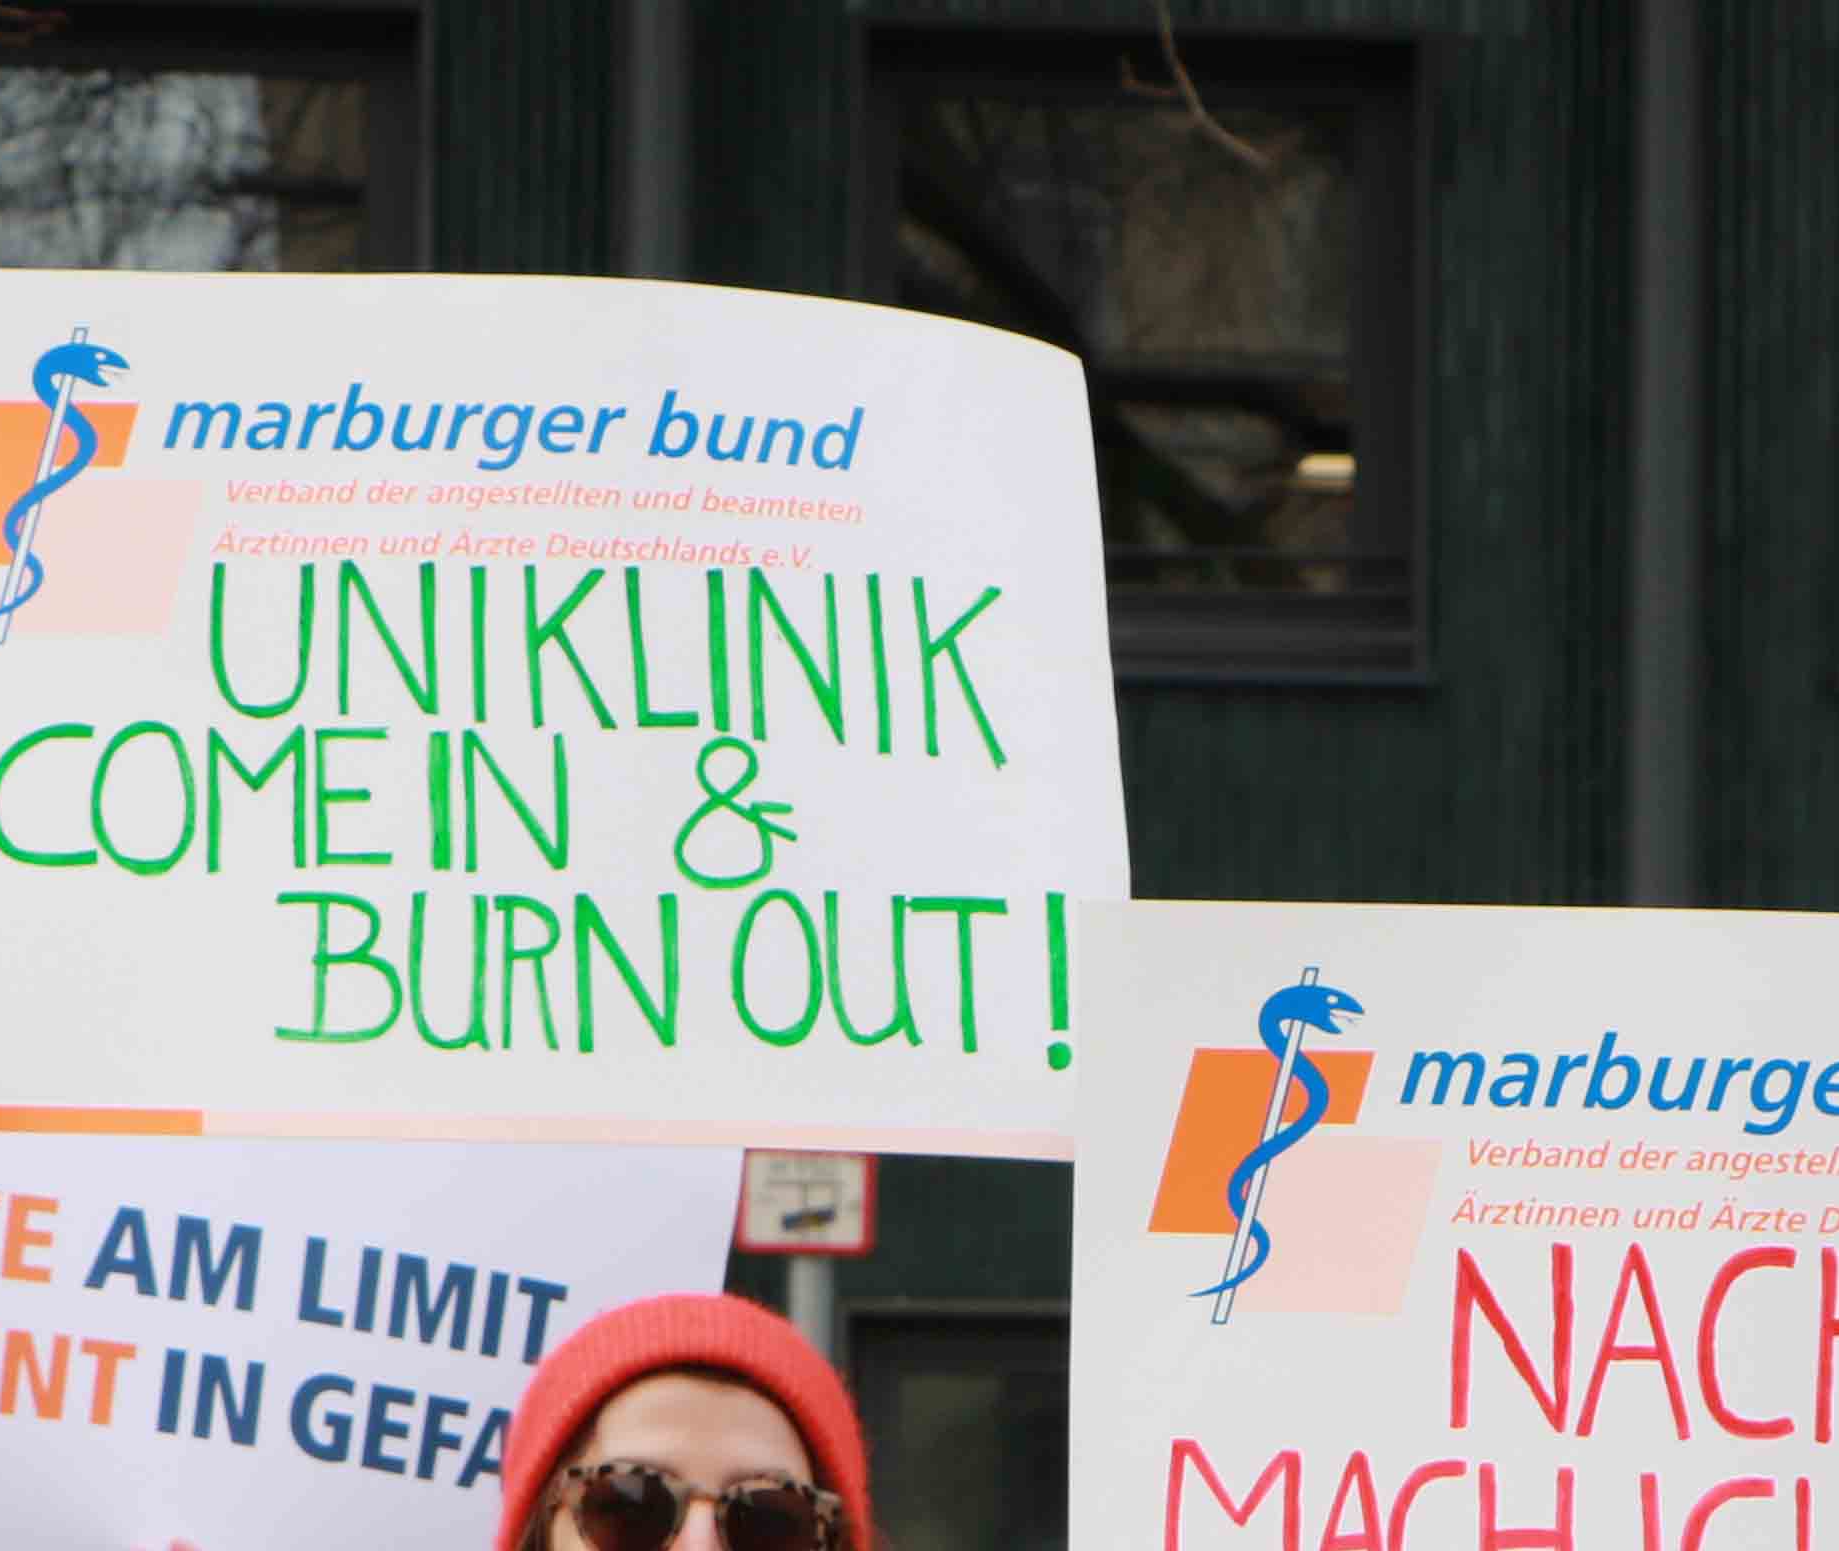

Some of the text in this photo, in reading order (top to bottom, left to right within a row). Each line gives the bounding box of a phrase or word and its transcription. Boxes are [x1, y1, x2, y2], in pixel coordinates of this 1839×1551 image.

[165, 383, 864, 471] marburger bund
[226, 478, 864, 524] Verband der angestellten und beamteten
[211, 521, 368, 557] Ärztinnen
[379, 530, 442, 556] und
[545, 532, 752, 567] Deutschlands
[674, 736, 799, 891] &
[1466, 1137, 1610, 1169] Verband
[1619, 1139, 1678, 1171] der
[1451, 1189, 1621, 1229] Ärztinnen
[1633, 1200, 1702, 1231] und
[1709, 1197, 1807, 1233] Ärzte
[84, 1205, 262, 1307] AM
[298, 1236, 568, 1366] LIMIT
[157, 1346, 266, 1446] IN
